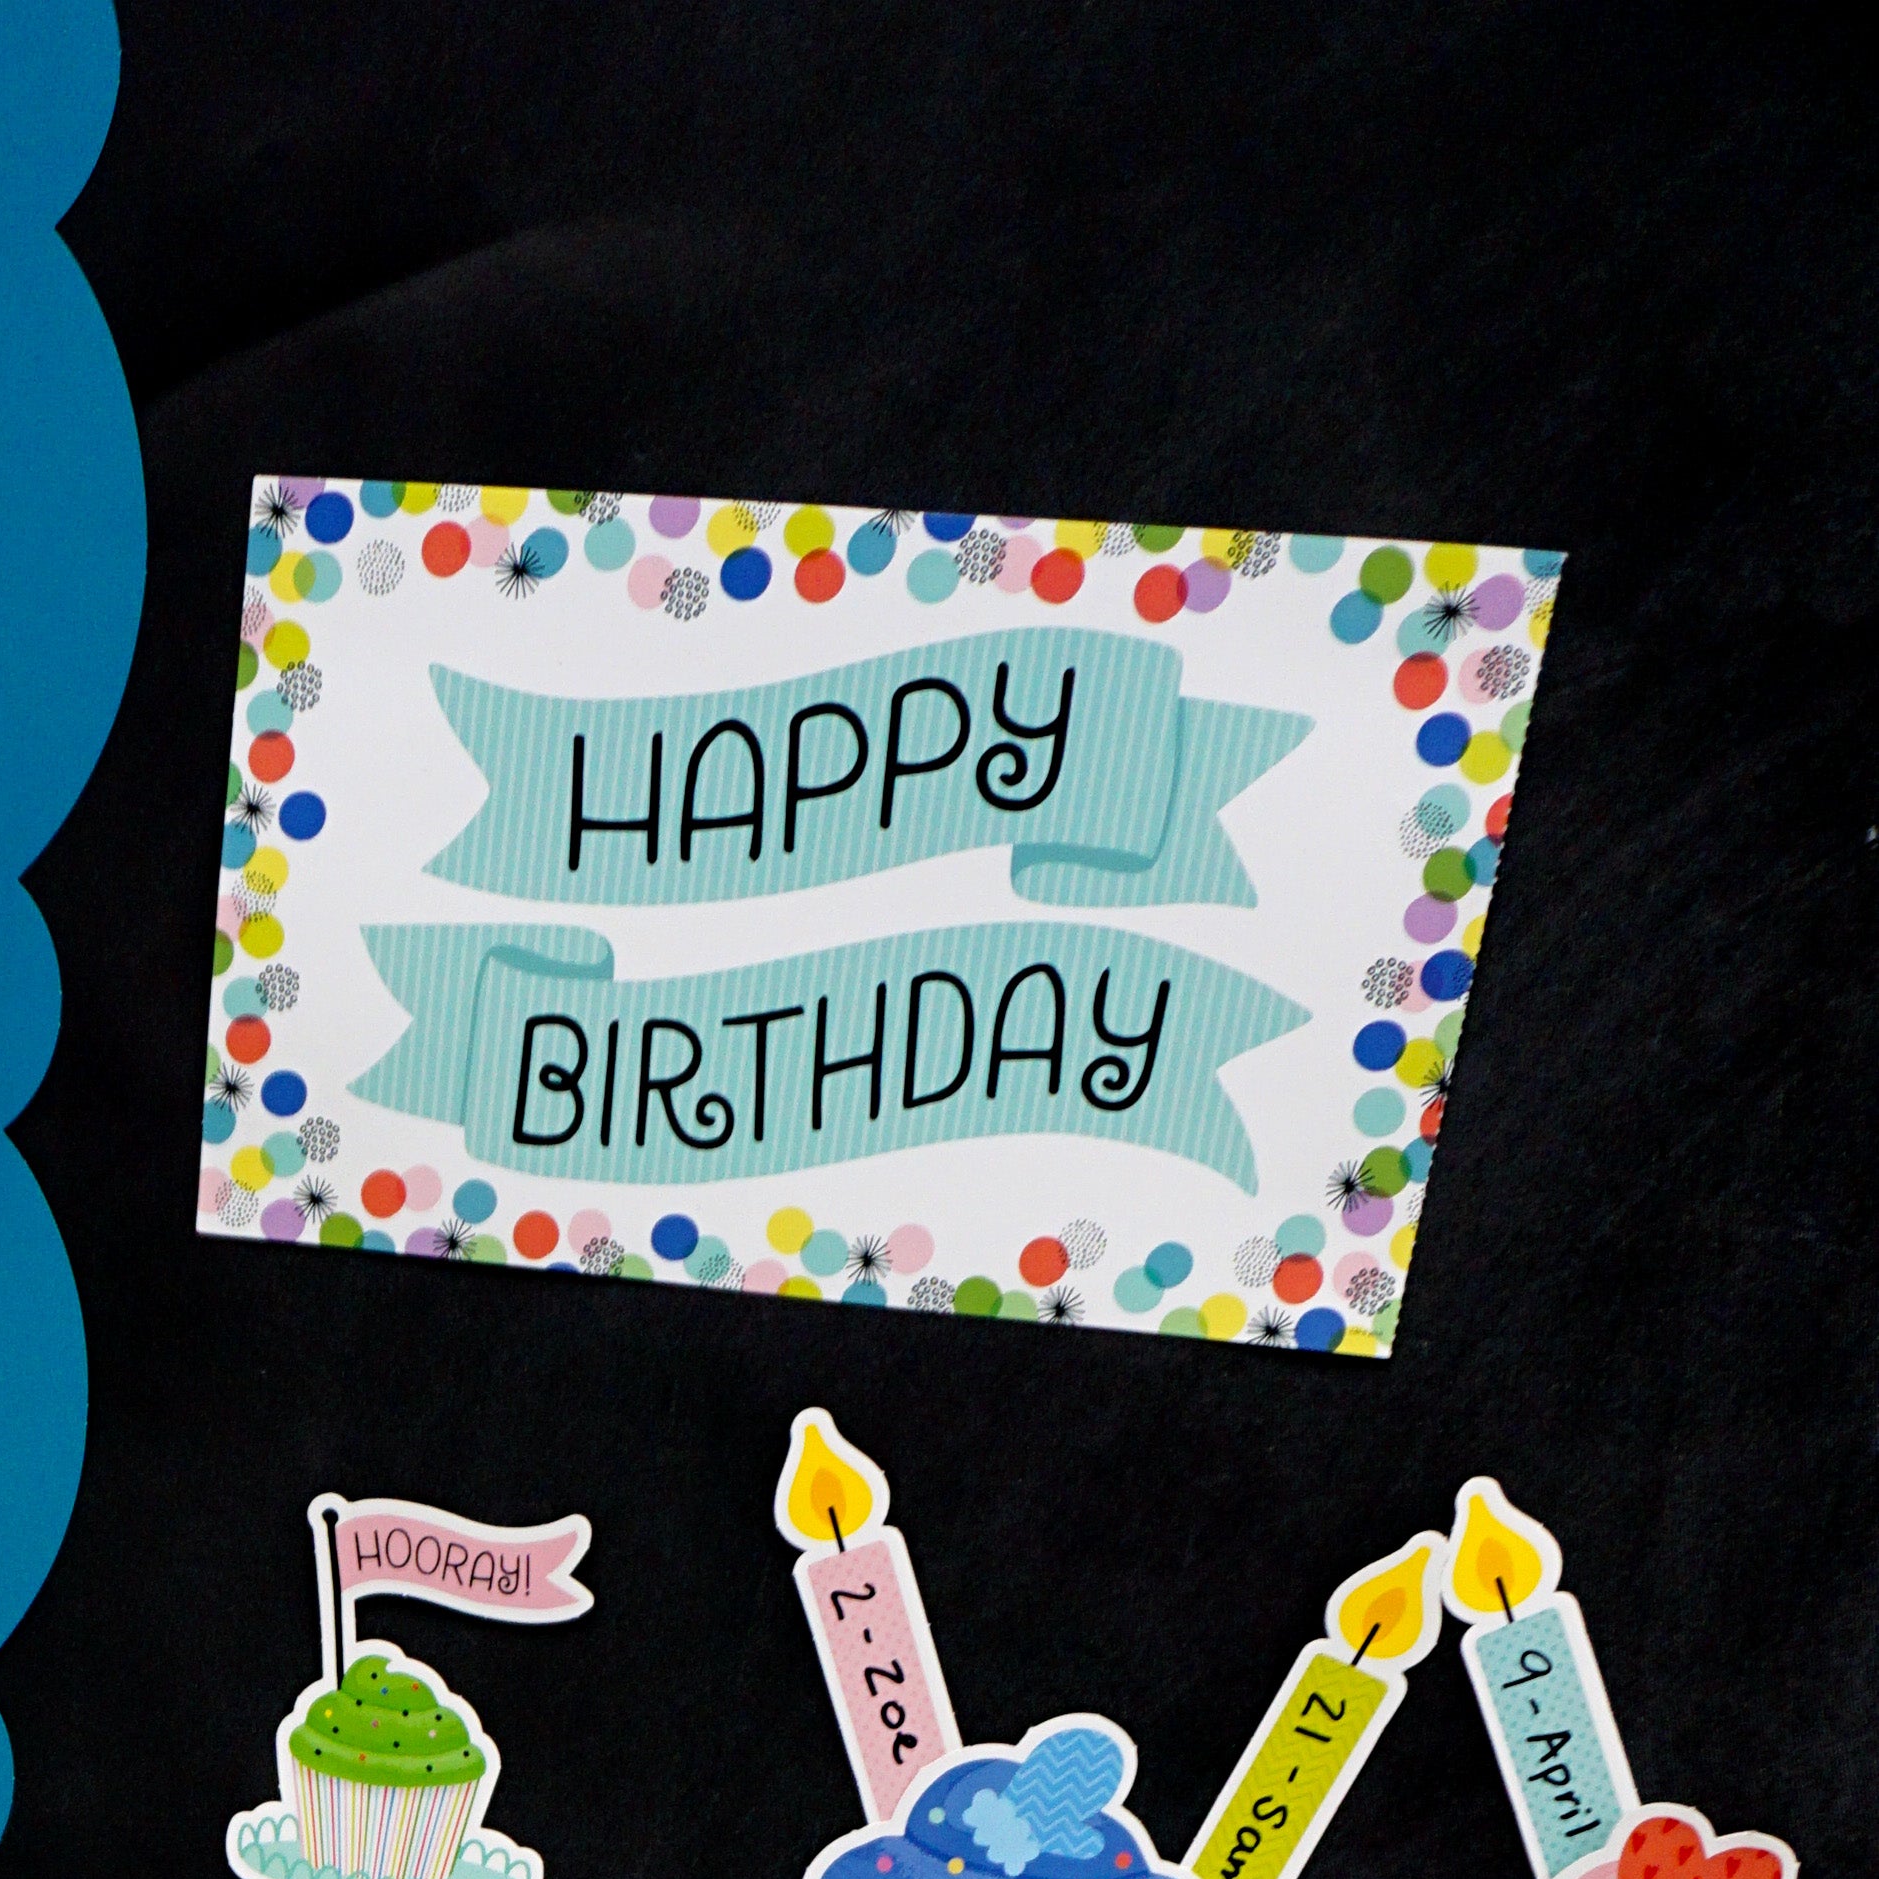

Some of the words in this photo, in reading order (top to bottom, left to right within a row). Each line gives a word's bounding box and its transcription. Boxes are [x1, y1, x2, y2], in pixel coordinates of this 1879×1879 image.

[567, 660, 1077, 872] HAPPY
[511, 962, 1172, 1151] BIRTHDAY
[353, 1527, 534, 1597] HOORAY!
